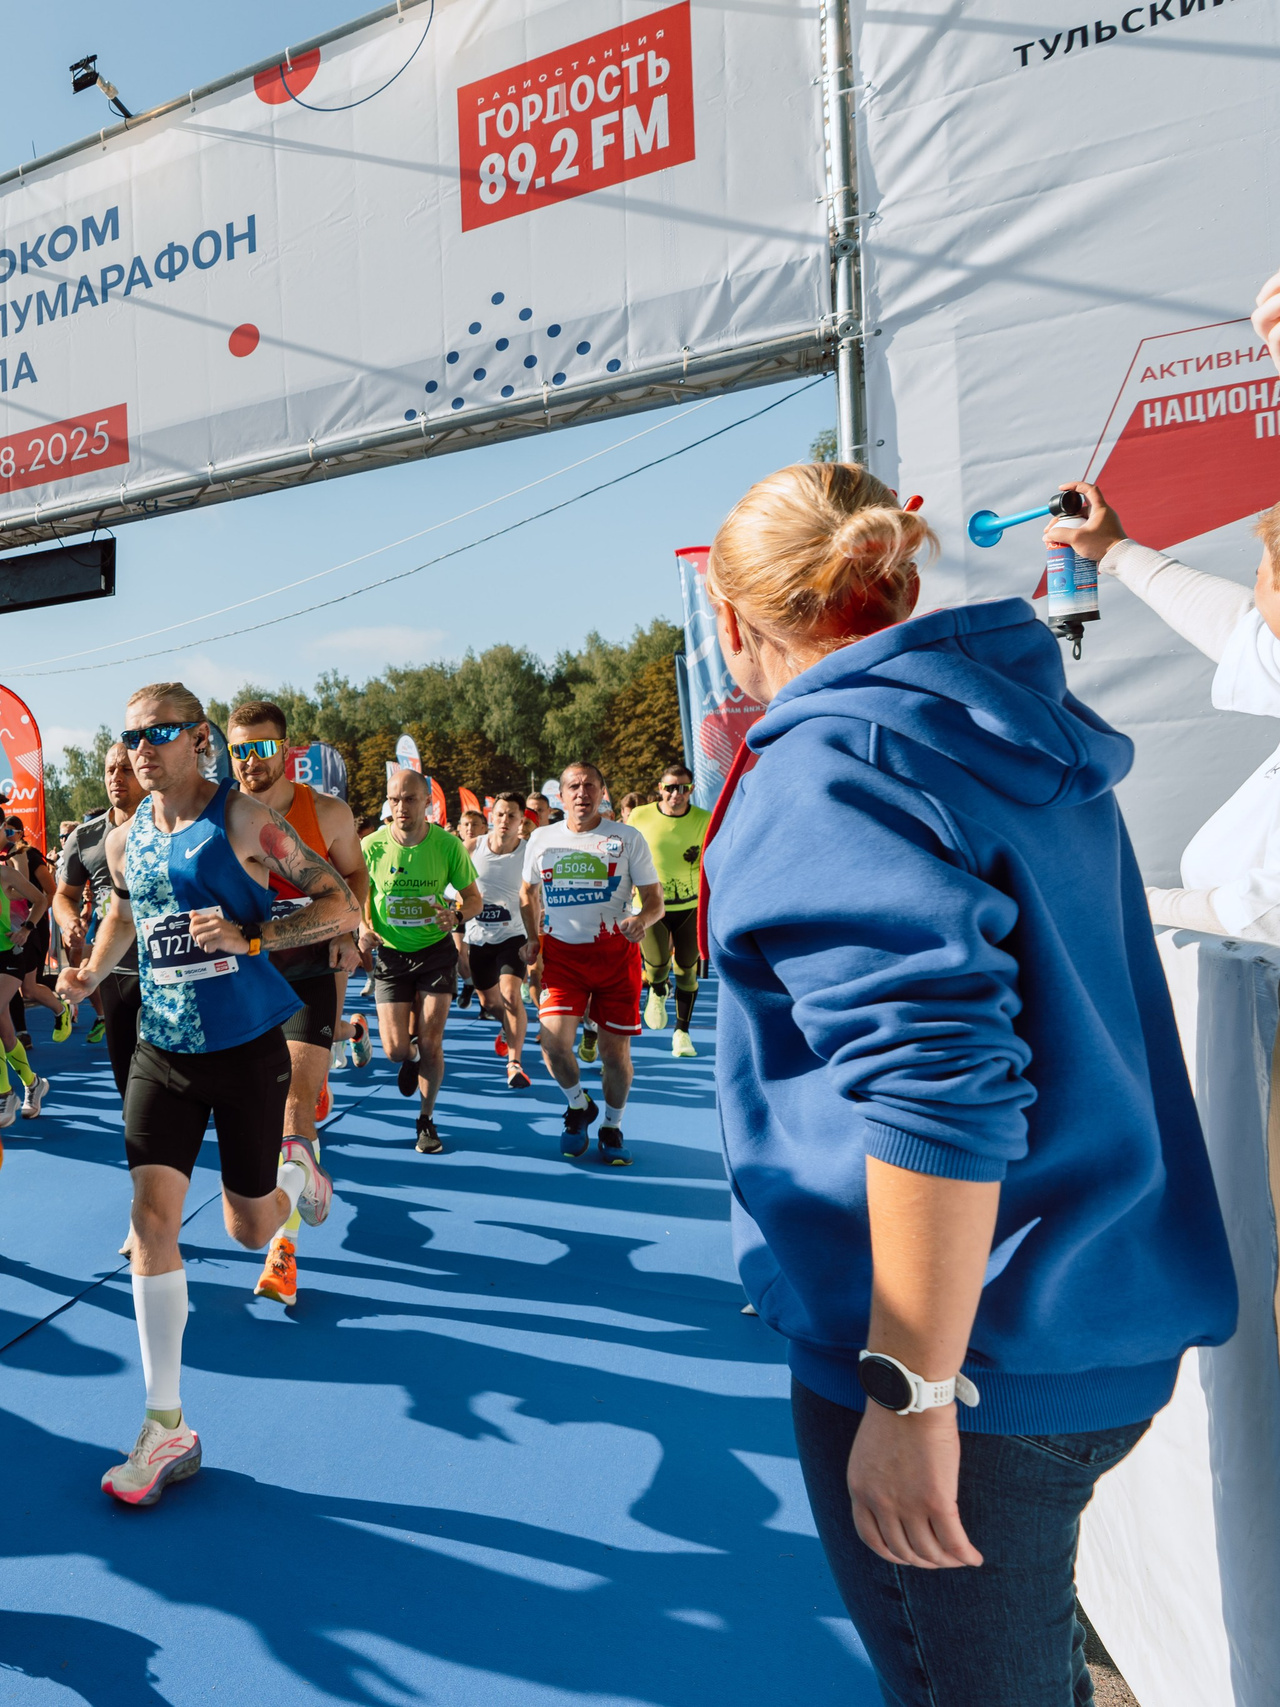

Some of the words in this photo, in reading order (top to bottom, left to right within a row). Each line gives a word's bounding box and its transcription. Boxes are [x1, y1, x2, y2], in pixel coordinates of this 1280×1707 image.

[1012, 0, 1236, 67] ТУЛЬСКИ
[476, 29, 666, 107] РАДИОСТАНЦИЯ
[478, 50, 671, 147] ГОРДОСТЬ
[478, 127, 580, 206] 89.2
[590, 93, 671, 171] FM
[1254, 409, 1280, 440] П
[564, 862, 596, 874] 5084
[399, 906, 423, 915] 5161
[547, 891, 605, 905] ОБЛАСТИ
[161, 933, 200, 957] 727
